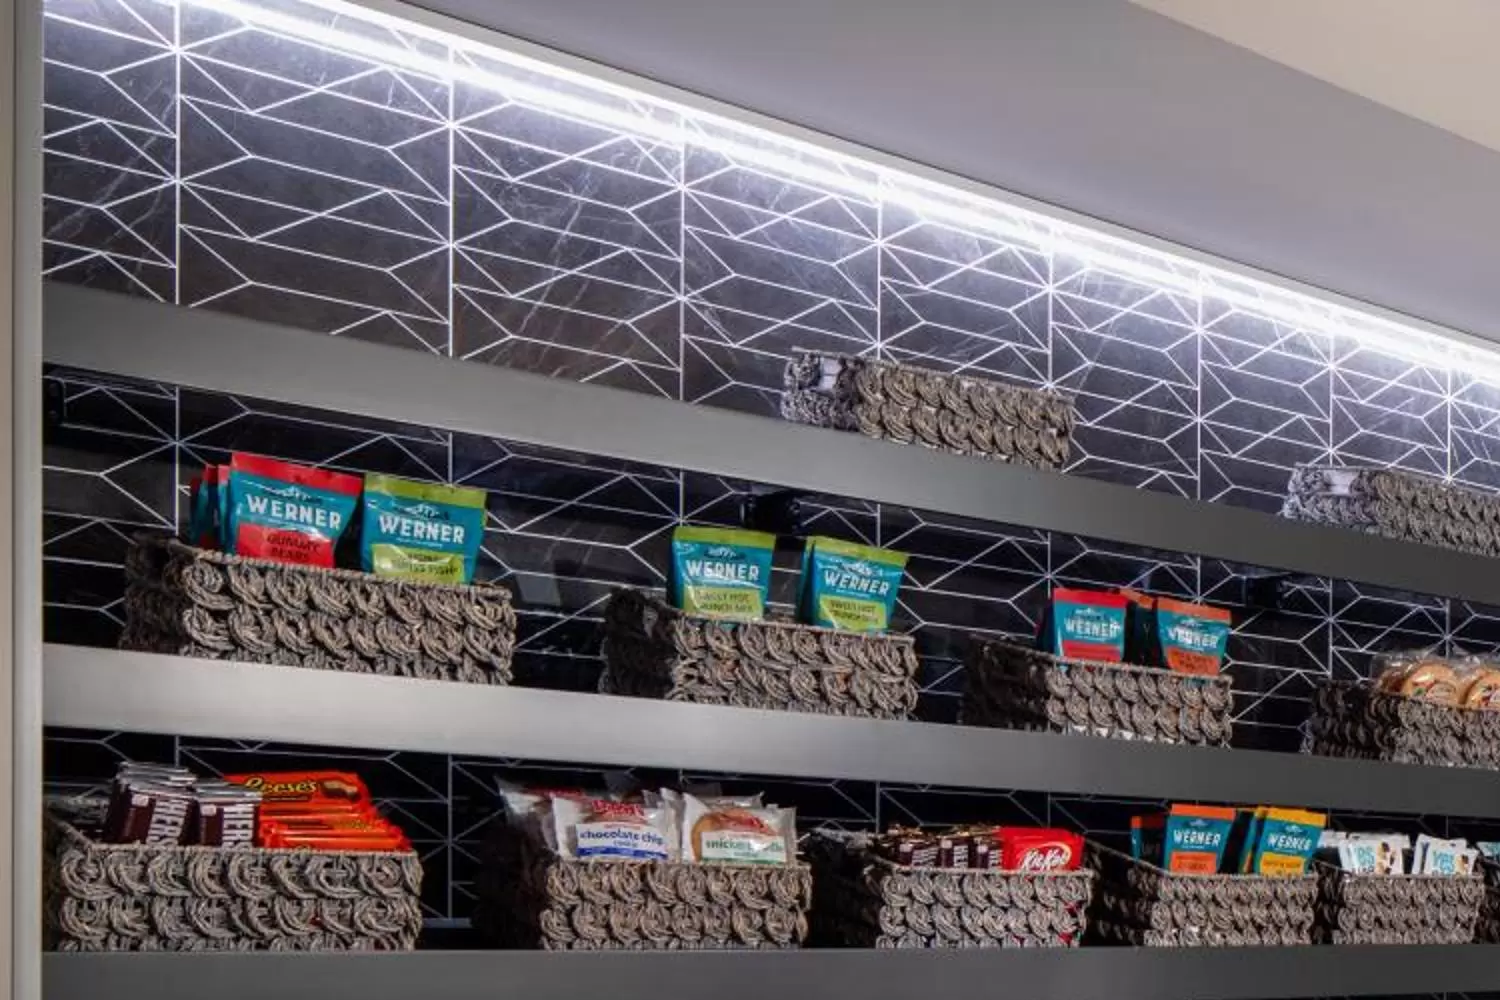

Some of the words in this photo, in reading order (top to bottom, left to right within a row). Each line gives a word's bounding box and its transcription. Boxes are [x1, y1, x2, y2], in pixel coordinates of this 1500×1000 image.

[245, 493, 342, 531] WERNER
[379, 514, 466, 545] WERNER
[686, 559, 760, 582] WERNER
[824, 569, 890, 597] WERNER
[1063, 616, 1121, 639] WERNER
[580, 829, 639, 841] chocolate
[1173, 828, 1222, 848] WERNER
[1266, 832, 1313, 851] WERNER
